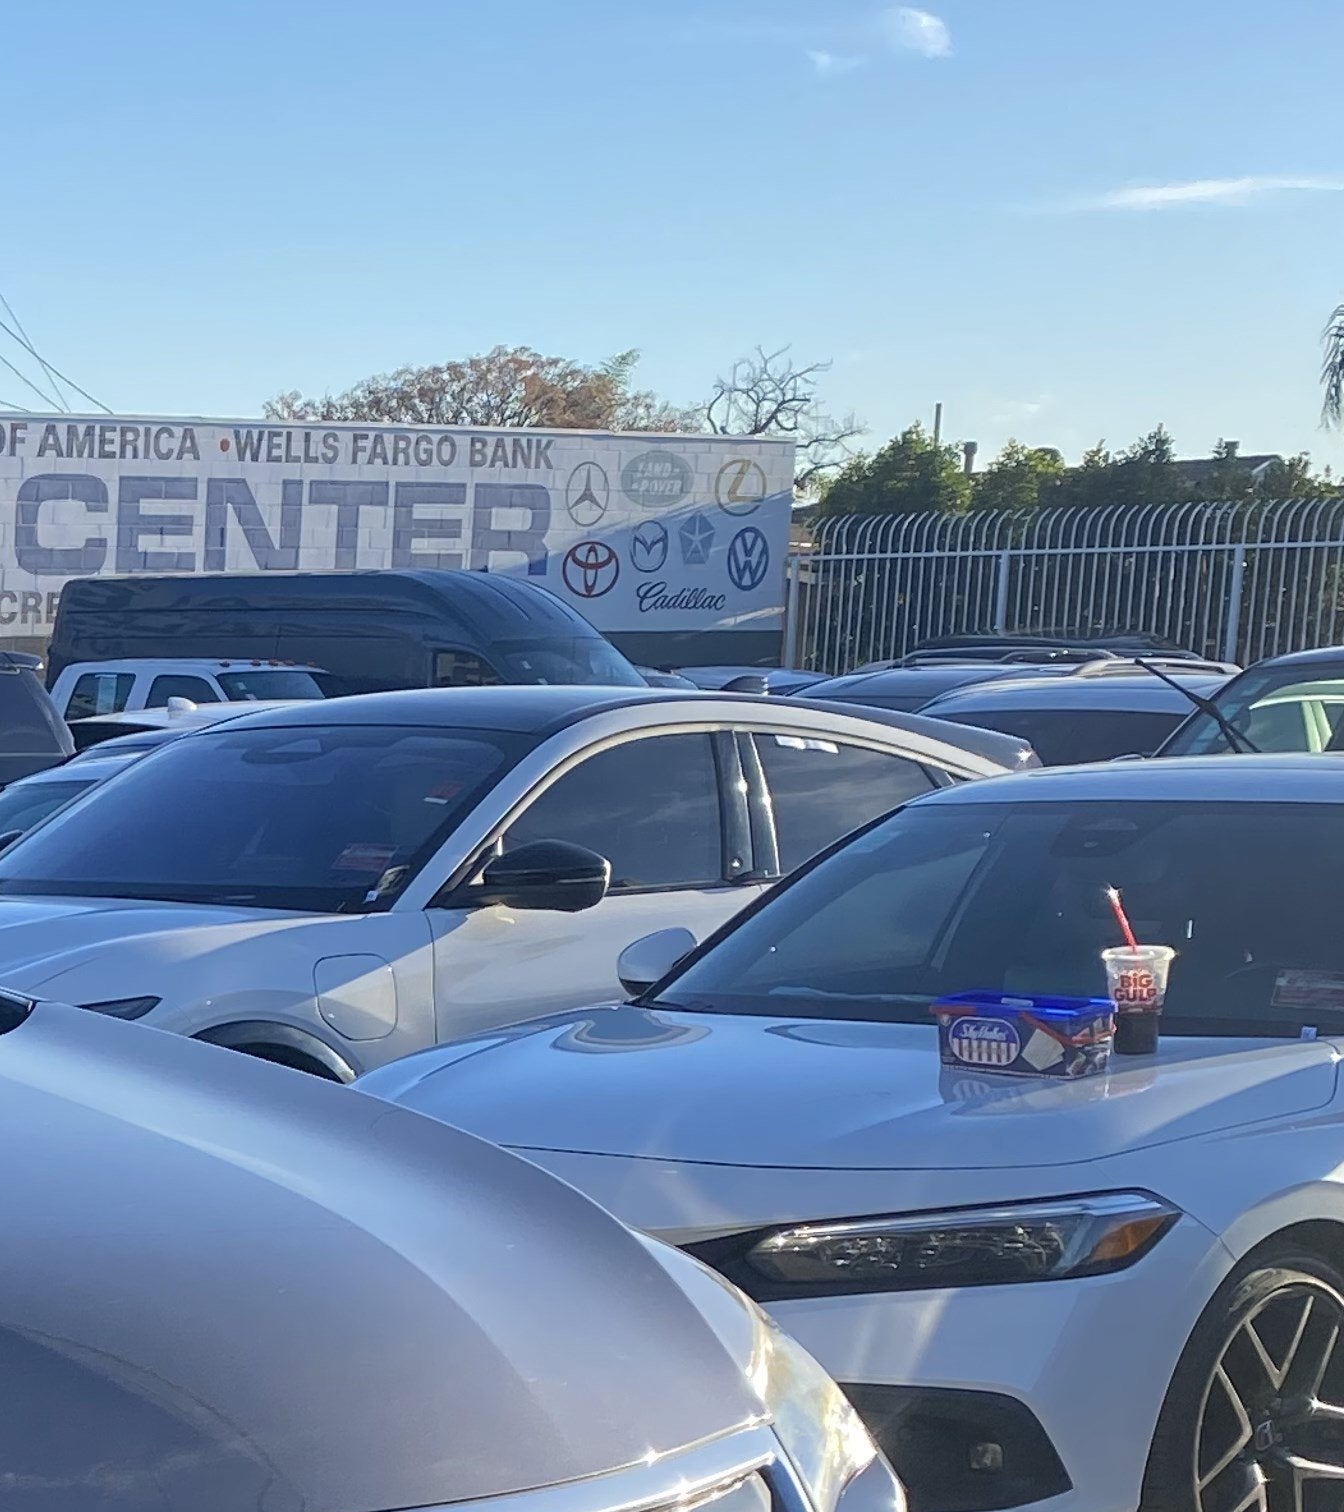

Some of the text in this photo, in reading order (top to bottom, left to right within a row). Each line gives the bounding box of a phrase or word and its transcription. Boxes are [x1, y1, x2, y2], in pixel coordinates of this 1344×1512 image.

[37, 424, 201, 461] AMERICA
[234, 429, 340, 465] WELLS
[351, 433, 458, 467] FARGO
[469, 436, 555, 470] BANK
[15, 473, 552, 575] CENTER
[636, 581, 726, 613] Cadillac
[1115, 988, 1157, 1002] GULP
